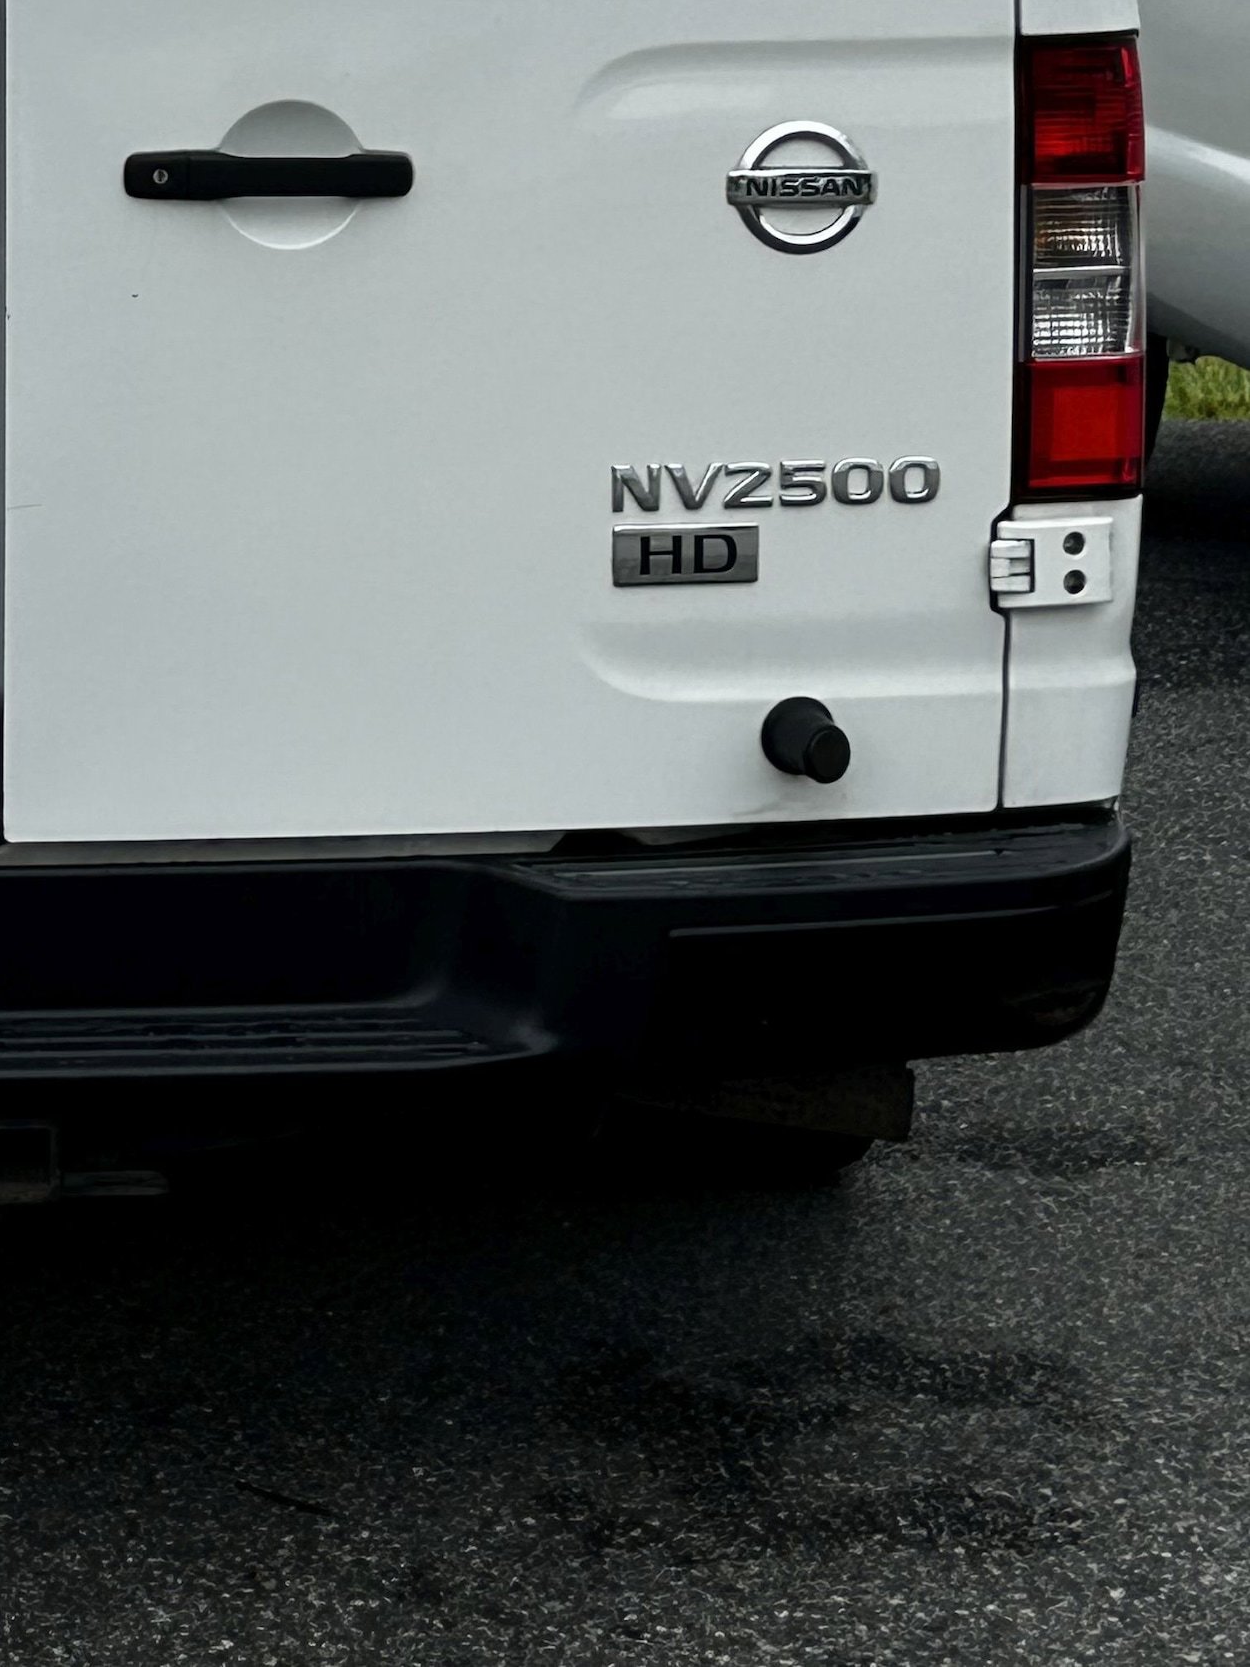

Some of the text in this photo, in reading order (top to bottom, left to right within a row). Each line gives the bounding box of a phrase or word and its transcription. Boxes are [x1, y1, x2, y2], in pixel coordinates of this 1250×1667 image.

[746, 177, 863, 197] NISSAN
[611, 455, 941, 512] NV2500
[639, 534, 738, 576] HD
